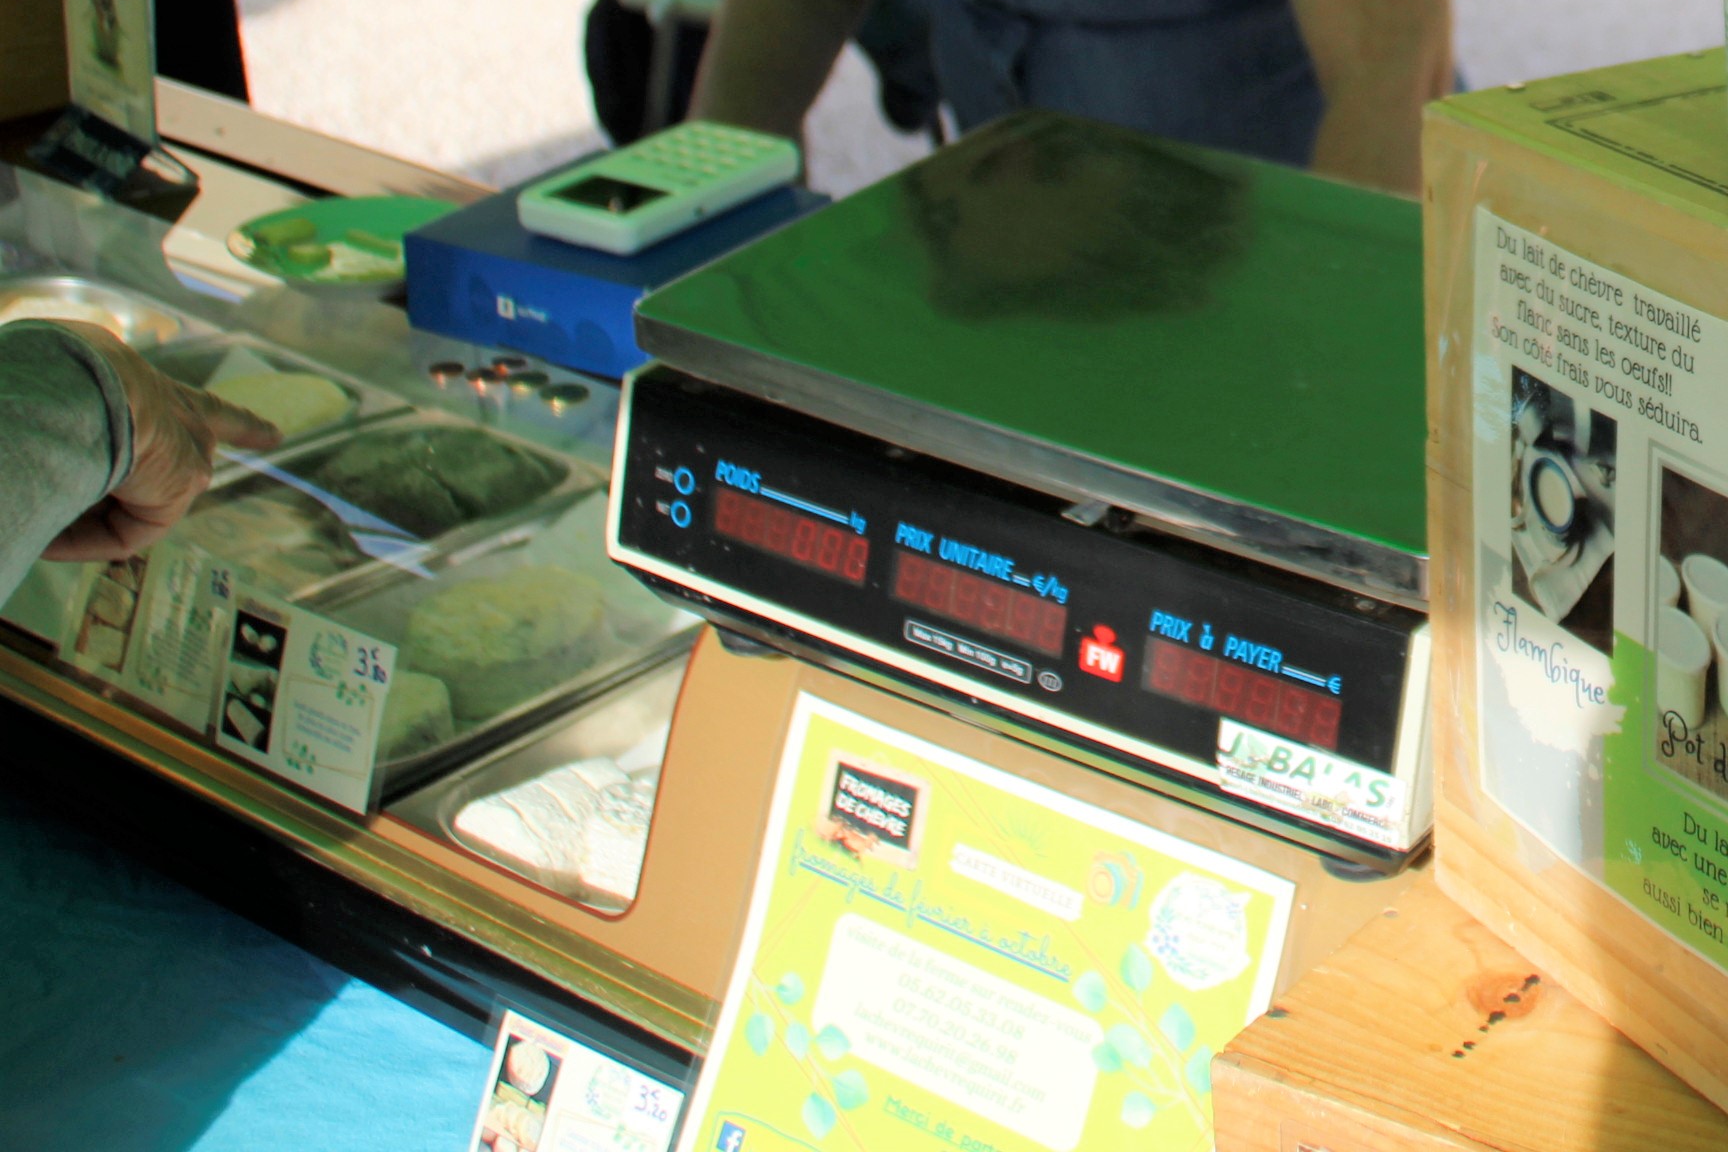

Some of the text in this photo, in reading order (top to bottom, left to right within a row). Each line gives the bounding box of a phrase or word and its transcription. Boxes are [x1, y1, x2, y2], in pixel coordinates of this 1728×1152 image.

[1496, 225, 1701, 343] Du lait de chèvre travaillé
[1499, 262, 1532, 294] avec
[1535, 280, 1555, 307] du
[1608, 316, 1666, 362] texture
[1671, 345, 1696, 375] du
[1516, 299, 1674, 397] flanc sans les oeufs!!
[1522, 334, 1553, 368] côté
[1556, 352, 1589, 389] frais
[1595, 375, 1633, 409] vous
[1638, 396, 1704, 445] séduira.
[715, 459, 761, 494] POIDS
[895, 520, 934, 555] PRIX
[938, 536, 1015, 582] UNITAIRE
[1087, 643, 1121, 674] FW
[1149, 608, 1193, 644] PRIX
[1223, 633, 1284, 674] PAYER
[1493, 601, 1605, 708] Flambique
[1661, 710, 1705, 765] Pot
[1652, 826, 1688, 862] avec
[1694, 852, 1728, 886] une
[1683, 811, 1708, 845] Du
[1643, 876, 1681, 917] aussi
[1688, 903, 1723, 944] bien
[1702, 887, 1720, 910] se
